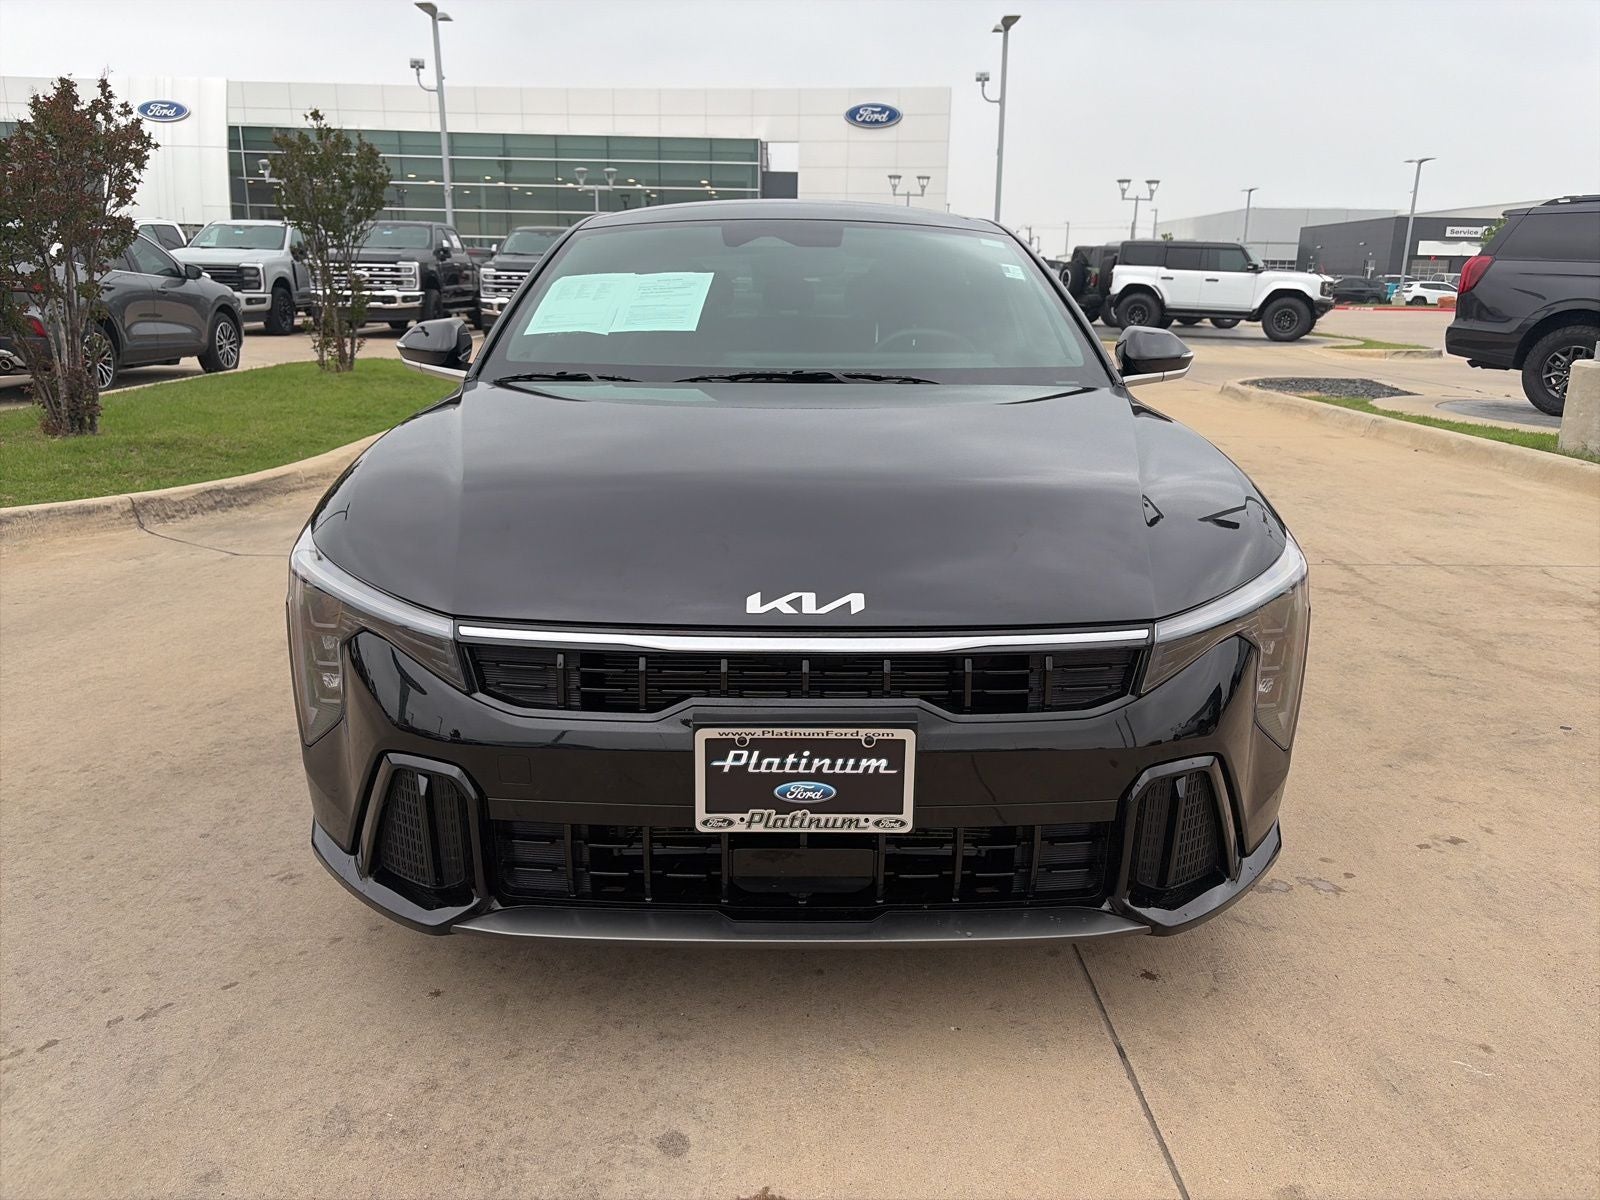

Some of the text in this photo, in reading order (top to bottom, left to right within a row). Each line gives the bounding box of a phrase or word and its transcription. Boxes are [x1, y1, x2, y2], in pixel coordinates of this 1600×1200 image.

[147, 103, 177, 116] Ford
[856, 107, 889, 122] Ford
[718, 730, 895, 738] www.PlatinumFord.com
[711, 750, 898, 774] Platinum
[786, 784, 823, 799] Ford
[706, 818, 729, 828] Ford
[744, 809, 870, 830] Platinum
[879, 818, 902, 828] Ford
